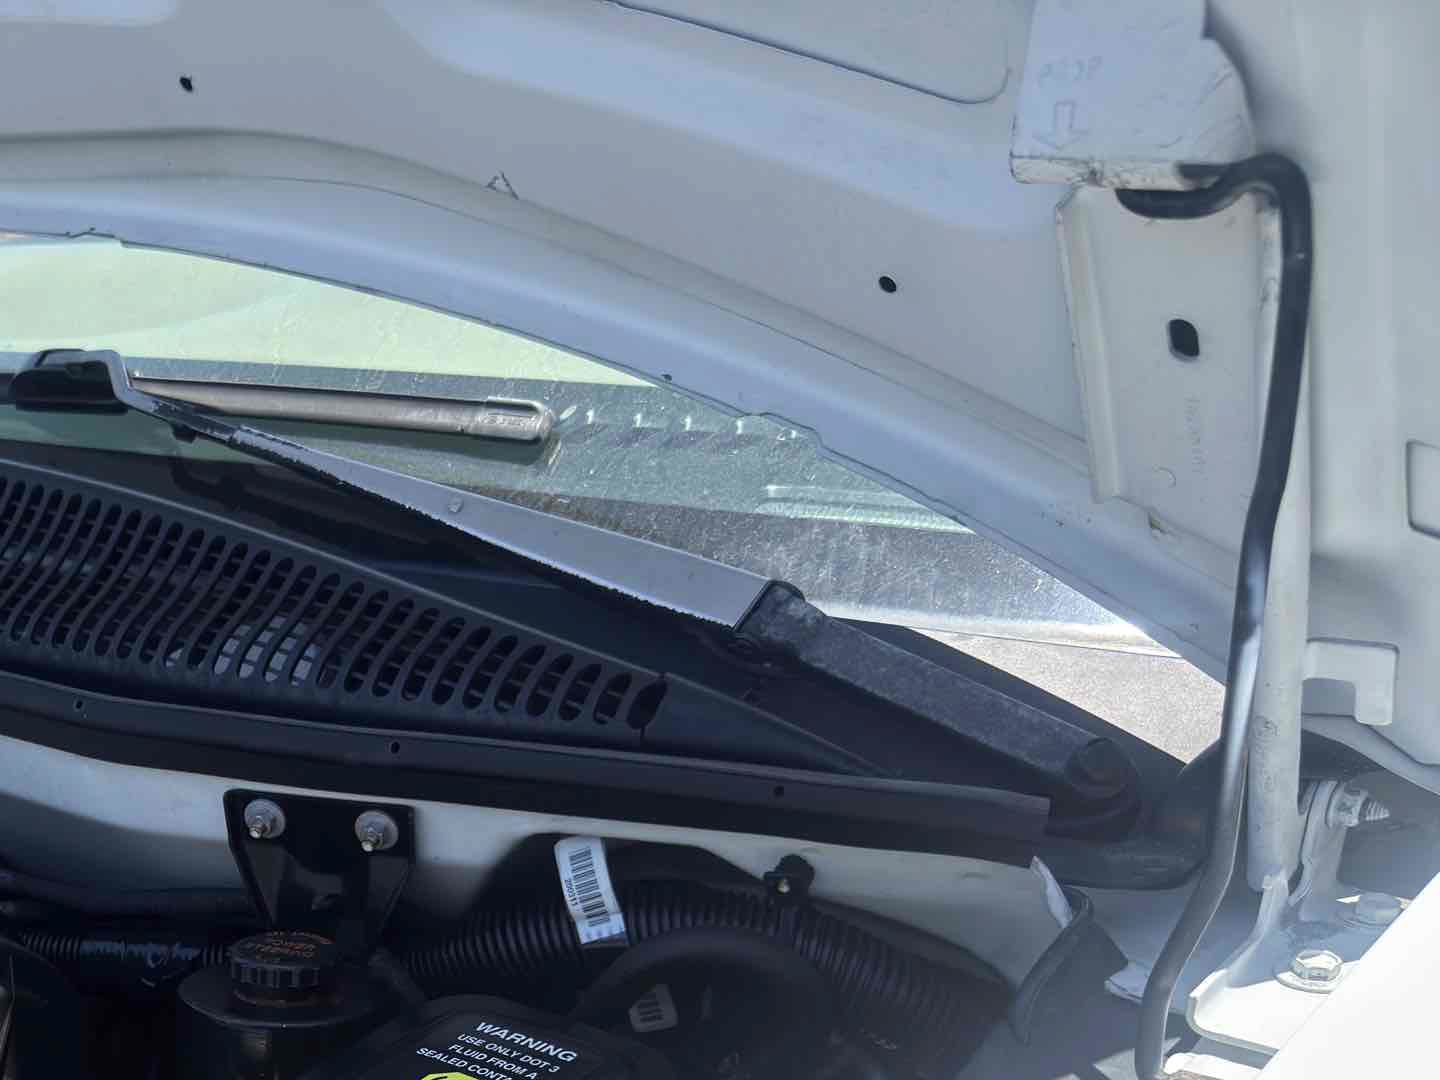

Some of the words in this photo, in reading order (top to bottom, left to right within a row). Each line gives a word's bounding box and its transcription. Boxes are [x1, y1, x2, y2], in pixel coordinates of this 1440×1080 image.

[416, 1047, 467, 1068] SEALED
[457, 1034, 484, 1047] USE
[485, 1042, 521, 1058] ONLY
[519, 1055, 551, 1068] DOT
[548, 1065, 560, 1073] 3
[475, 1022, 579, 1062] WARNING
[448, 1044, 488, 1061] FLUID
[486, 1057, 529, 1076] FROM
[525, 1072, 538, 1080] A
